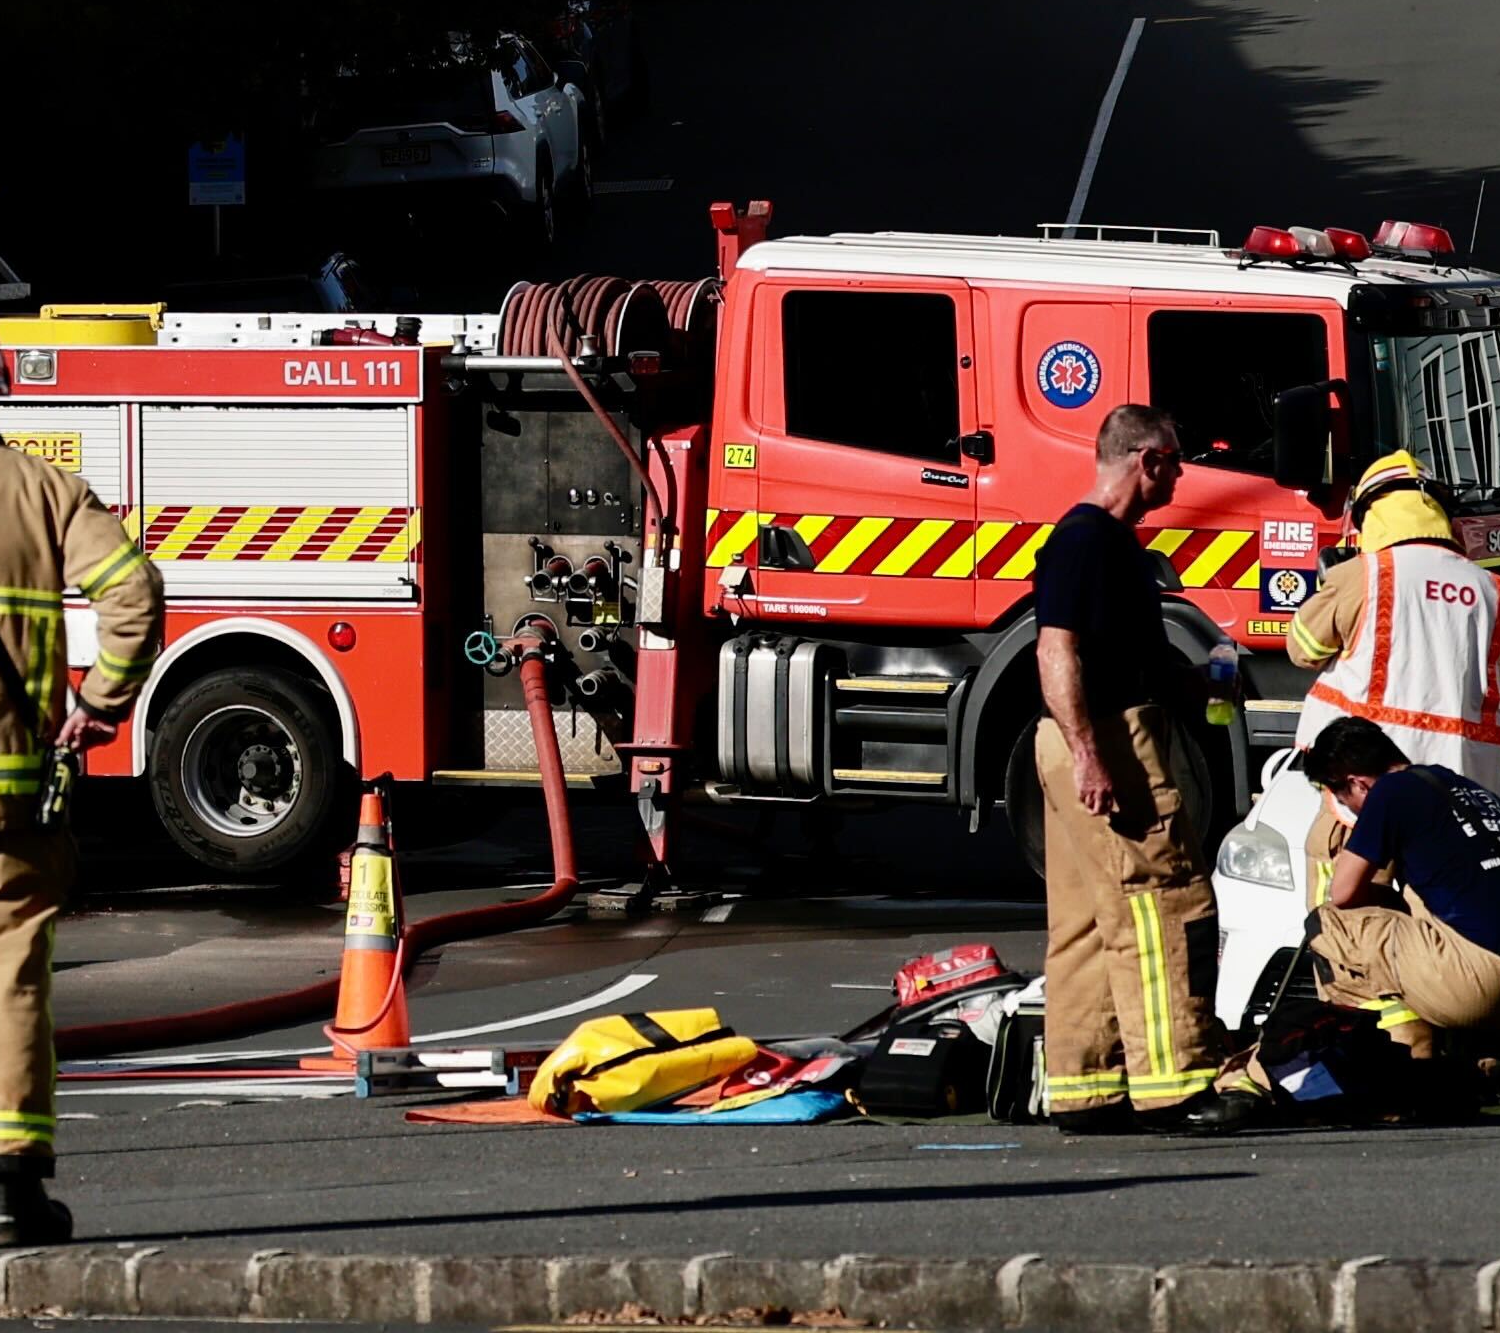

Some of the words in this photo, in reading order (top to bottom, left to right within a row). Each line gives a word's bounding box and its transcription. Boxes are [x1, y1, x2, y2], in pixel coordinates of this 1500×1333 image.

[284, 361, 357, 386] CALL
[363, 361, 401, 386] 111
[727, 447, 753, 465] 274
[1263, 521, 1314, 541] FIRE
[1263, 541, 1314, 551] EMERGENCY
[1426, 580, 1476, 606] ECO
[763, 603, 788, 613] TARE
[1253, 621, 1288, 634] ELLE
